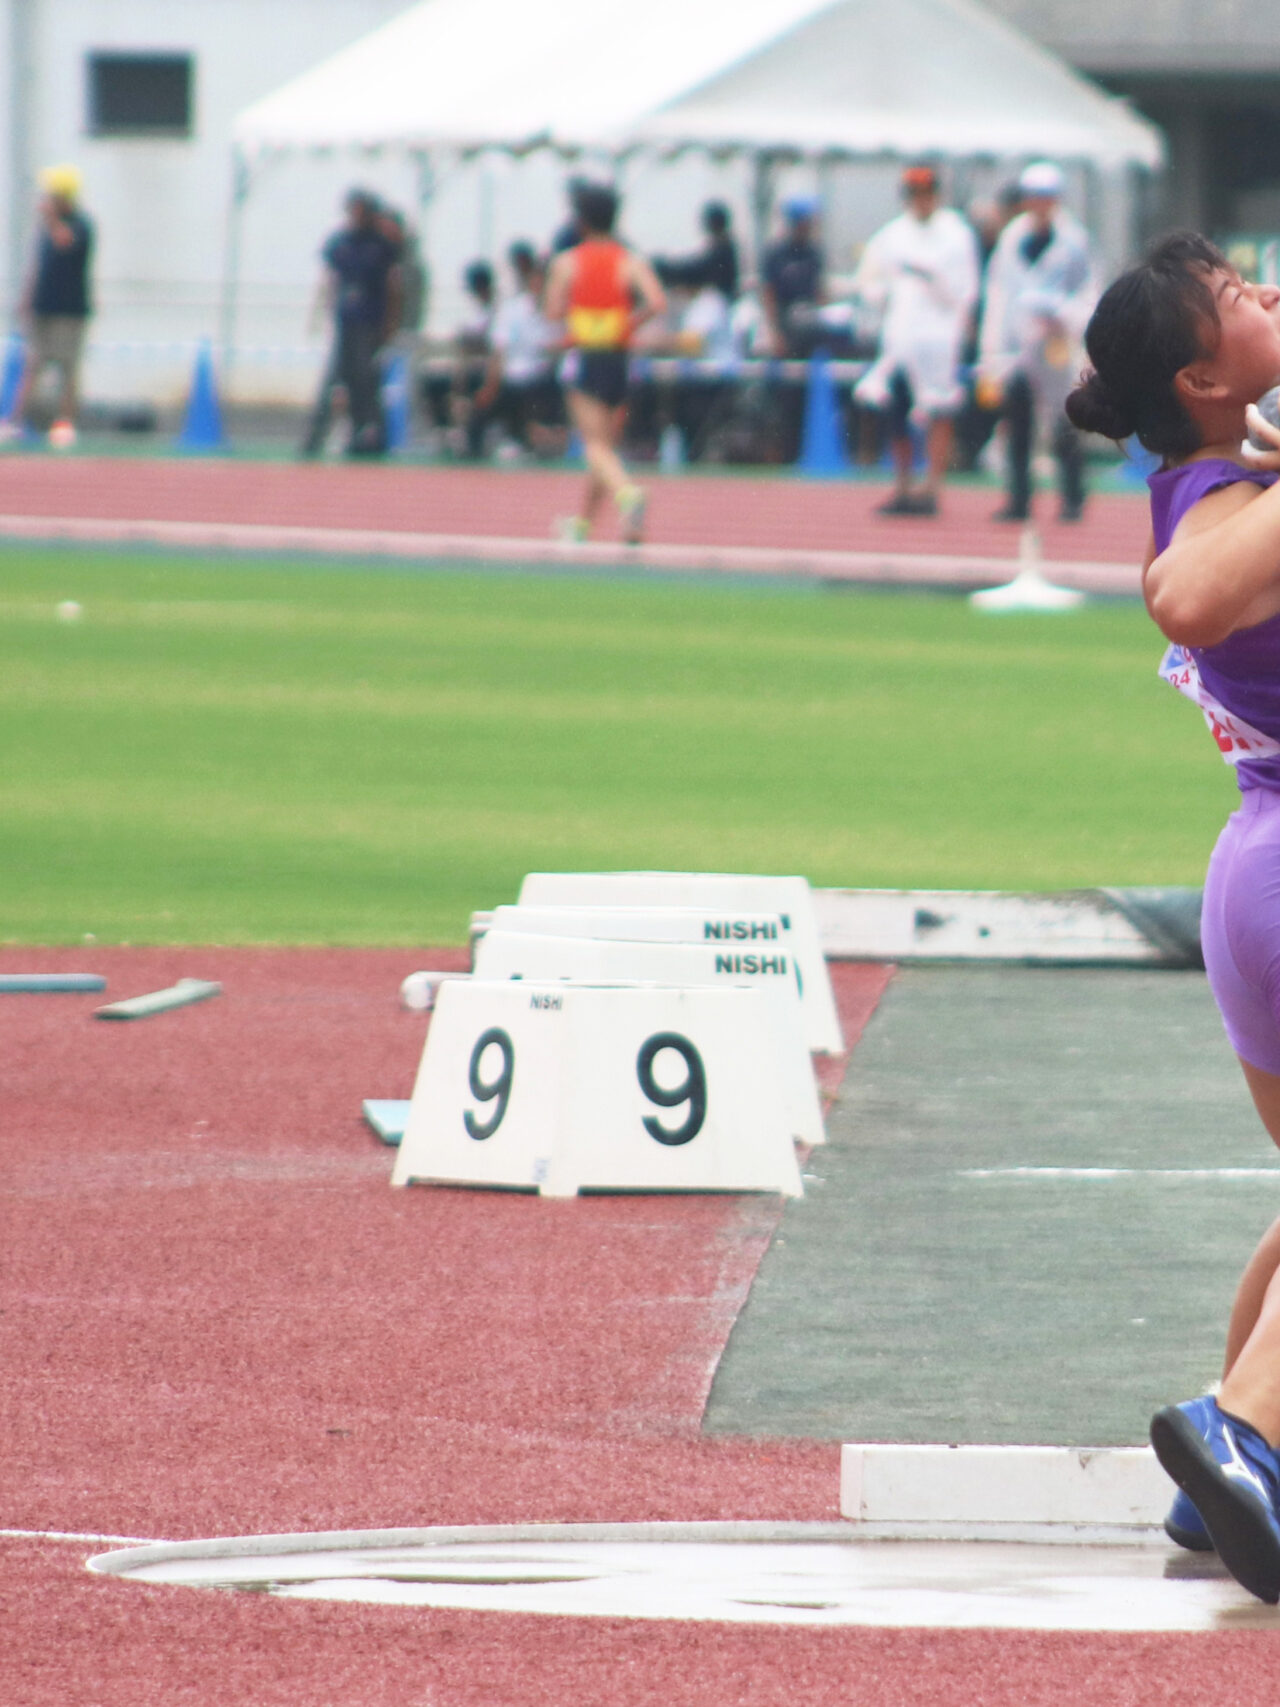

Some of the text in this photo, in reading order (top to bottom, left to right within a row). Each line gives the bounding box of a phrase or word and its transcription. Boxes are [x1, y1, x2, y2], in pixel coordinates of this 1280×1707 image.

[703, 920, 778, 940] NISHI
[715, 954, 787, 975] NISHI
[530, 993, 563, 1011] NISHI
[463, 1026, 515, 1141] 9
[636, 1031, 708, 1147] 9
